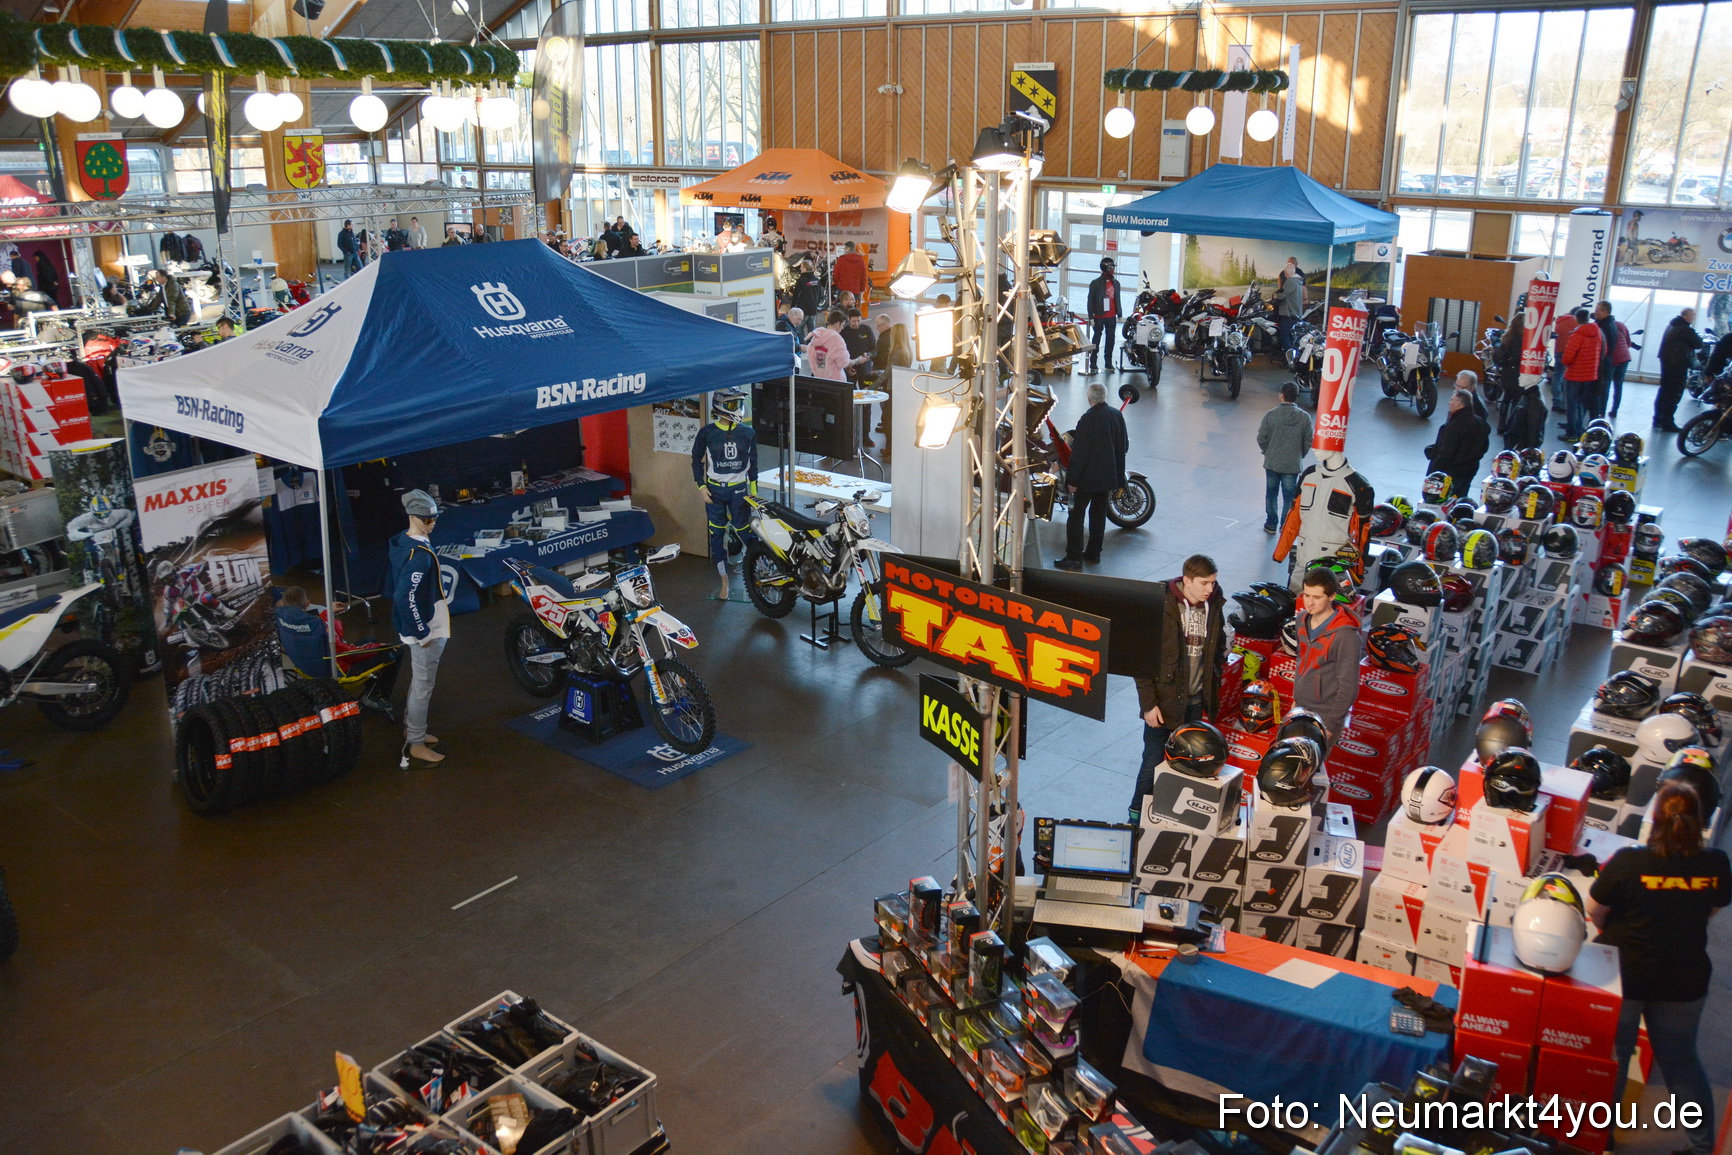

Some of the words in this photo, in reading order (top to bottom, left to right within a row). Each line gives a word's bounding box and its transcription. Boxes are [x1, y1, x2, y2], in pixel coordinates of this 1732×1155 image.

[754, 172, 792, 180] KTM
[830, 171, 862, 181] KTM
[694, 192, 714, 200] KTM
[740, 194, 762, 202] KTM
[790, 196, 813, 205] KTM
[840, 194, 860, 204] KTM
[1106, 214, 1128, 224] BMW
[1130, 216, 1169, 226] Motorrad
[1334, 228, 1347, 237] BMW
[1348, 224, 1366, 235] Motorrad
[1581, 230, 1605, 308] Motorrad
[1618, 268, 1669, 278] Schwandorf
[1530, 285, 1558, 295] SALE
[1617, 278, 1660, 288] Neumarkt
[473, 318, 568, 338] Husqvarna
[1332, 315, 1366, 331] SALE
[530, 329, 574, 338] MOTORCYCLES
[536, 372, 646, 409] BSN-Racing
[174, 395, 244, 434] BSN-Racing
[654, 407, 670, 416] 2017
[716, 460, 743, 470] Husqvarna
[143, 479, 228, 512] MAXXIS
[188, 498, 230, 514] REIFEN
[538, 529, 609, 557] MOTORCYCLES
[629, 574, 647, 588] 25
[884, 561, 1102, 642] MOTORRAD
[536, 598, 565, 624] 25
[1401, 618, 1422, 626] HJC
[886, 582, 1100, 698] TAF
[1369, 682, 1404, 693] ROCC
[923, 694, 979, 766] KASSE
[1340, 741, 1374, 755] ROCC
[657, 746, 720, 776] Husqvarna
[1335, 784, 1369, 798] ROCC
[1191, 802, 1214, 812] HJC
[1343, 846, 1353, 866] HJC
[1461, 1020, 1501, 1035] AHEAD
[1462, 1012, 1510, 1029] ALWAYS
[1541, 1036, 1583, 1049] AHEAD
[1542, 1028, 1591, 1044] ALWAYS
